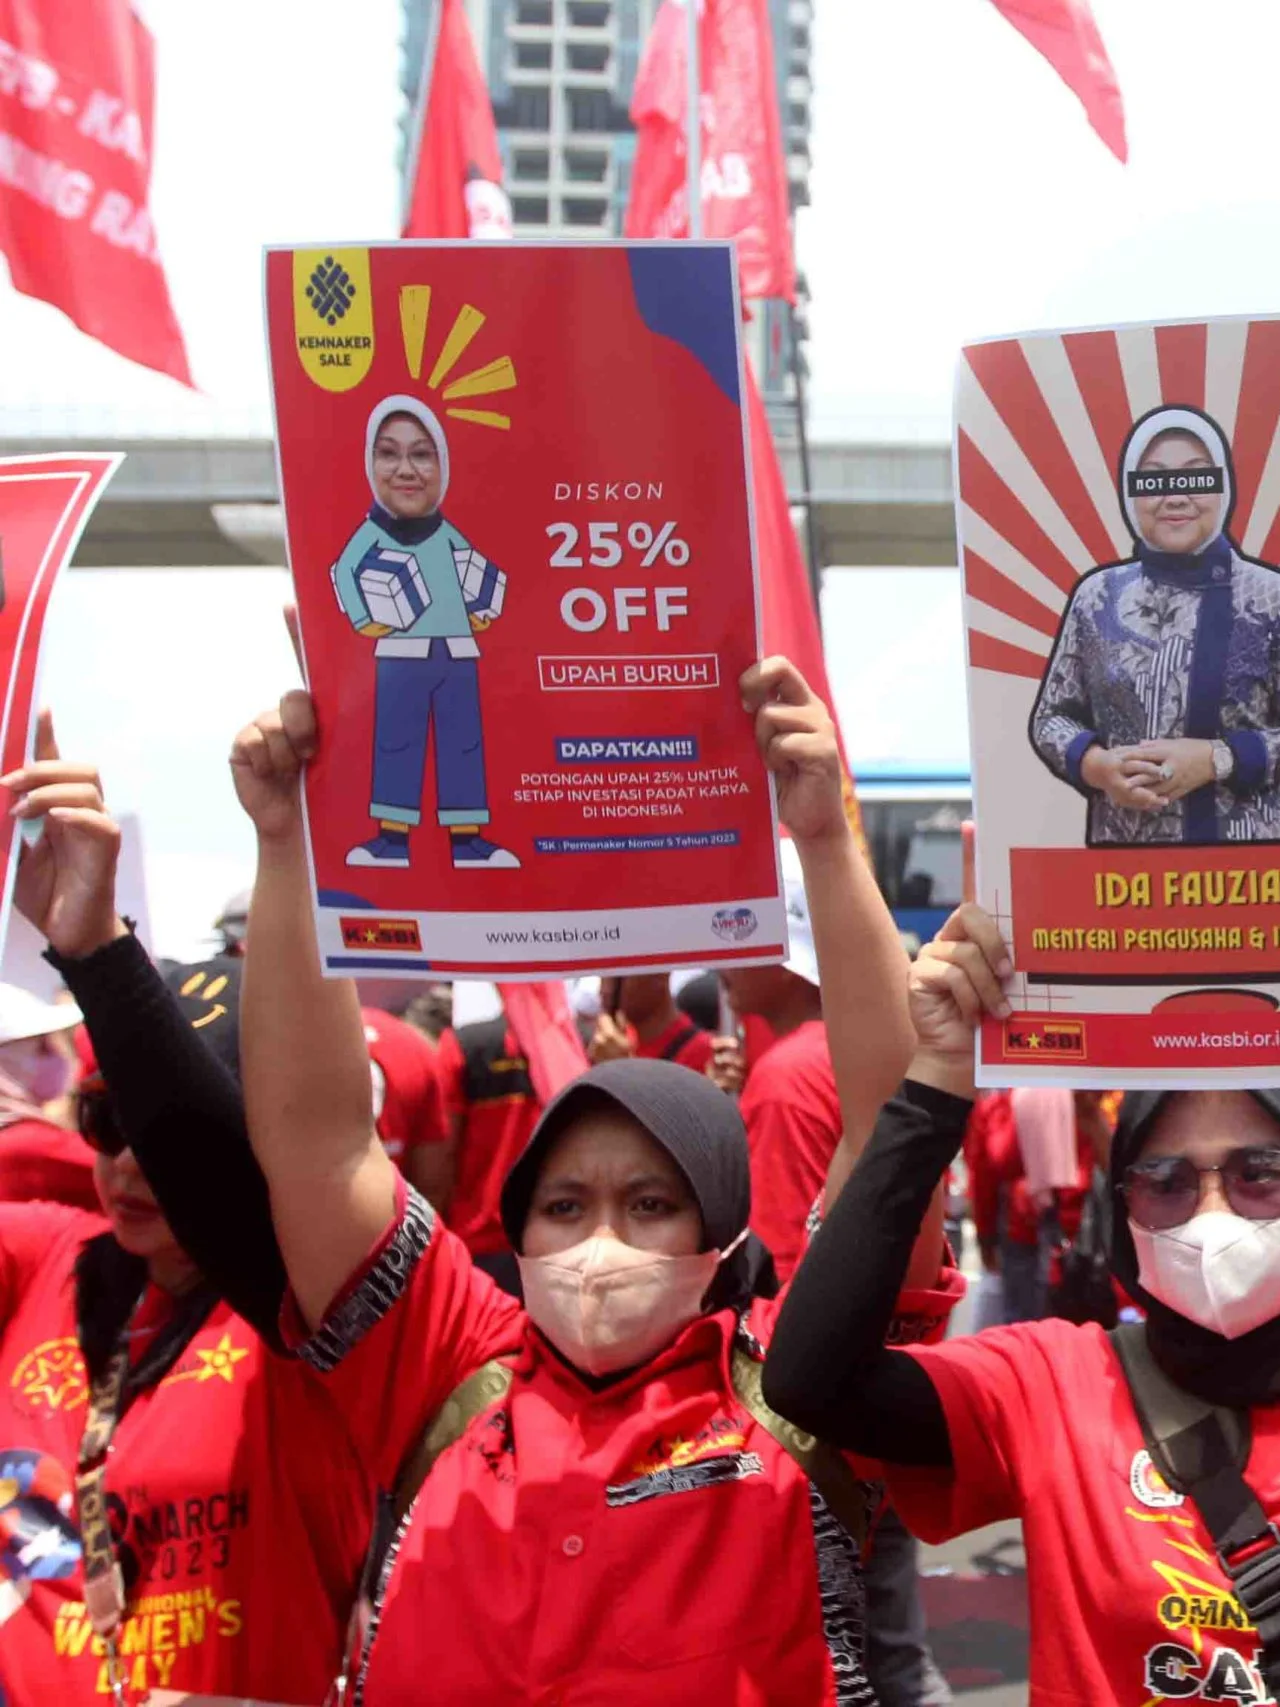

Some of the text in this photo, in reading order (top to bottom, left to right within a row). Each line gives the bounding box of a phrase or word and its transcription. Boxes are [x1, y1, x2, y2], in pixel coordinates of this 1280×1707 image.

[299, 336, 371, 349] KEMNAKER
[319, 353, 352, 366] SALE
[554, 482, 664, 500] DISKON
[1136, 475, 1215, 490] NOT FOUND
[545, 521, 690, 568] 25%
[560, 586, 689, 633] OFF
[550, 664, 708, 683] UPAH BURUH
[561, 740, 693, 758] DAPATKAN!!!
[521, 766, 739, 786] POTONGAN UPAH 25% UNTUK
[514, 782, 750, 803] SETIAP INVESTASI PADAT KARYA
[583, 804, 684, 818] DI INDONESIA
[563, 839, 626, 850] Permenaker
[628, 838, 664, 849] Nomor
[675, 835, 708, 846] Tahun
[710, 833, 736, 844] 2023
[1094, 871, 1152, 908] IDA
[486, 925, 620, 945] www.kasbi.or.id
[1032, 926, 1117, 951] MENTERI
[1124, 925, 1242, 951] PENGUSAHA
[1250, 926, 1265, 951] &
[132, 1488, 249, 1547] MARCH
[142, 1534, 230, 1582] 2023
